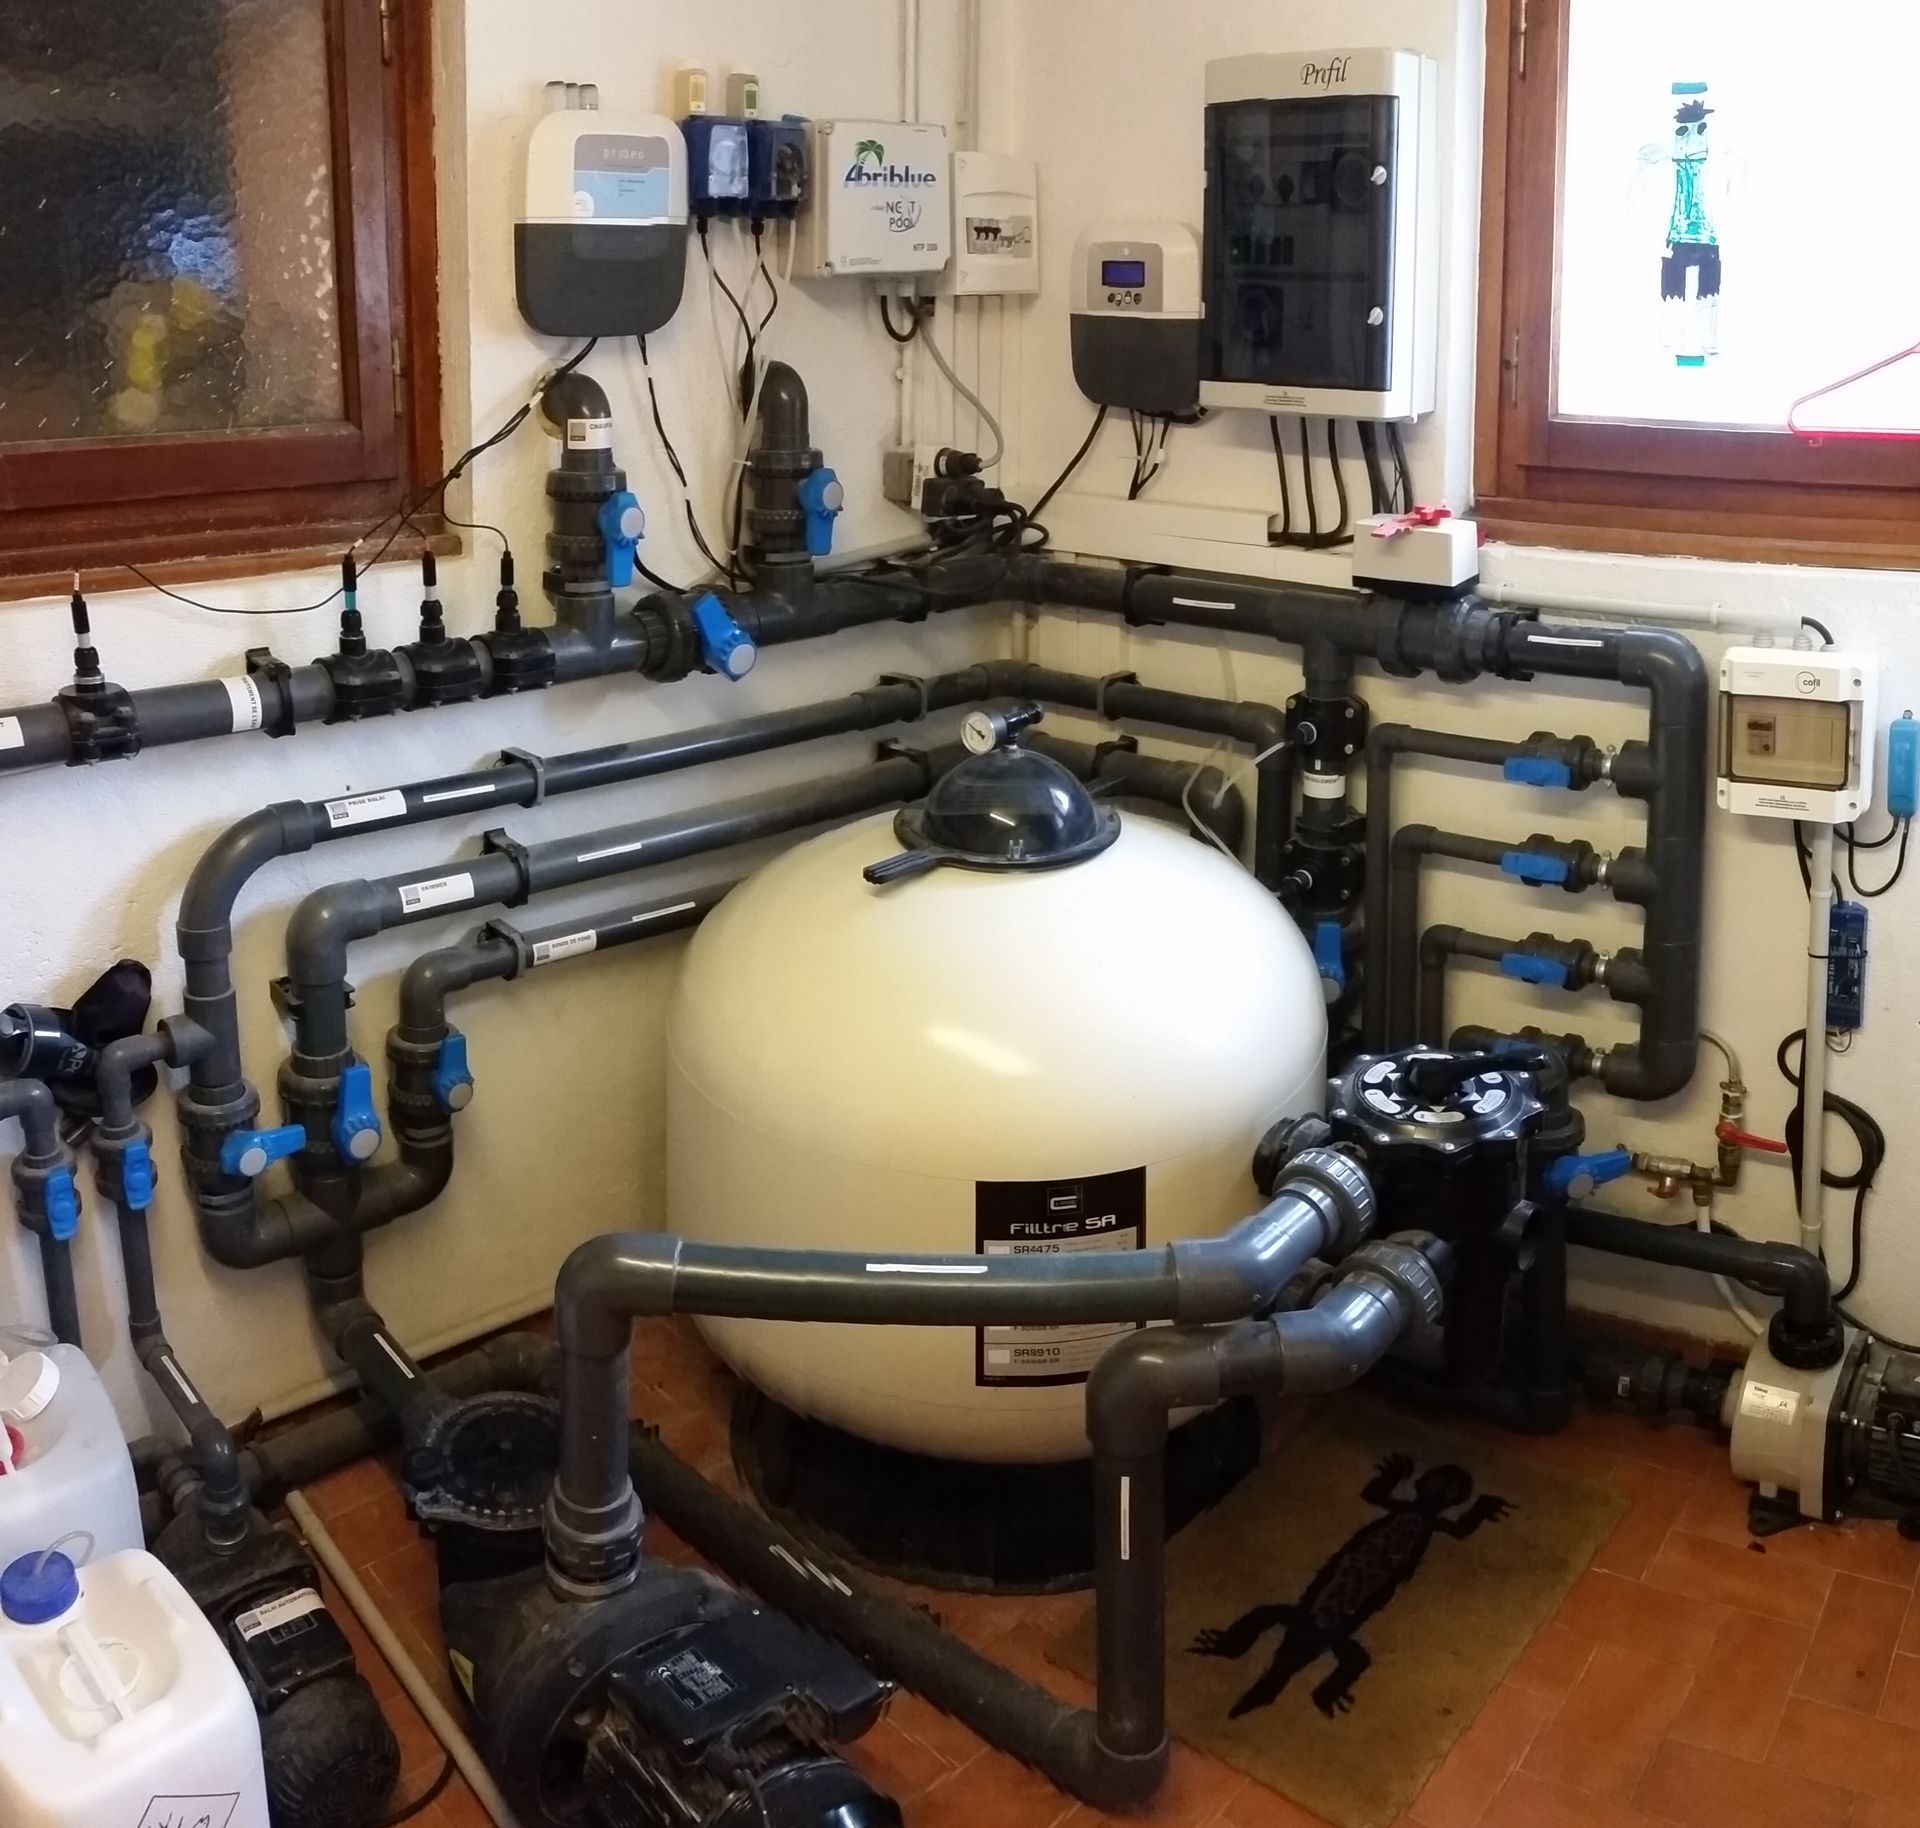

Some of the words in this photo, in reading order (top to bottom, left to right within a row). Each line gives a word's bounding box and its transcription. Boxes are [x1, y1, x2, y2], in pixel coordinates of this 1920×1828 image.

[844, 163, 937, 184] Abriblue
[889, 217, 915, 229] POOL
[1085, 1214, 1117, 1230] SA
